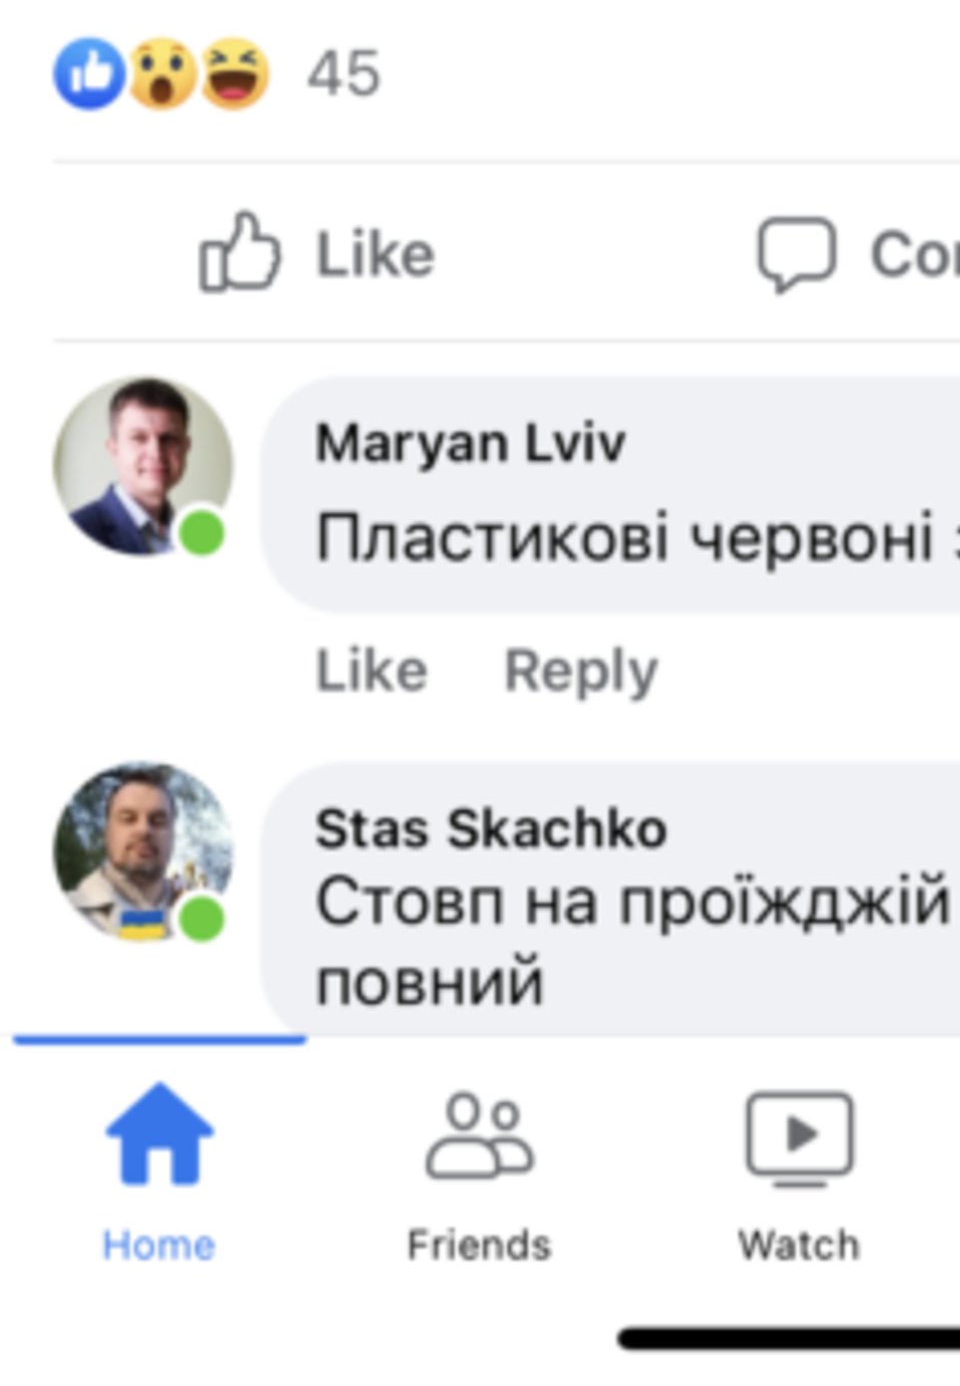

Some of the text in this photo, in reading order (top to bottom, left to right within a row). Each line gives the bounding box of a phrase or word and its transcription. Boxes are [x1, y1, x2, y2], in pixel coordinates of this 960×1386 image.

[307, 49, 380, 97] 45
[318, 227, 435, 278] Like
[316, 418, 627, 474] Maryan Lviv
[318, 508, 668, 563] Пластикові
[690, 508, 932, 574] червоні
[317, 645, 428, 693] Like
[506, 646, 659, 702] Reply
[315, 805, 668, 851] Stas Skachko
[316, 873, 504, 927] Стовп
[526, 885, 598, 926] на
[620, 870, 950, 937] проїжджій
[317, 951, 543, 1007] повний
[103, 1230, 216, 1261] Home
[408, 1227, 552, 1262] Friends
[737, 1227, 860, 1262] Watch
